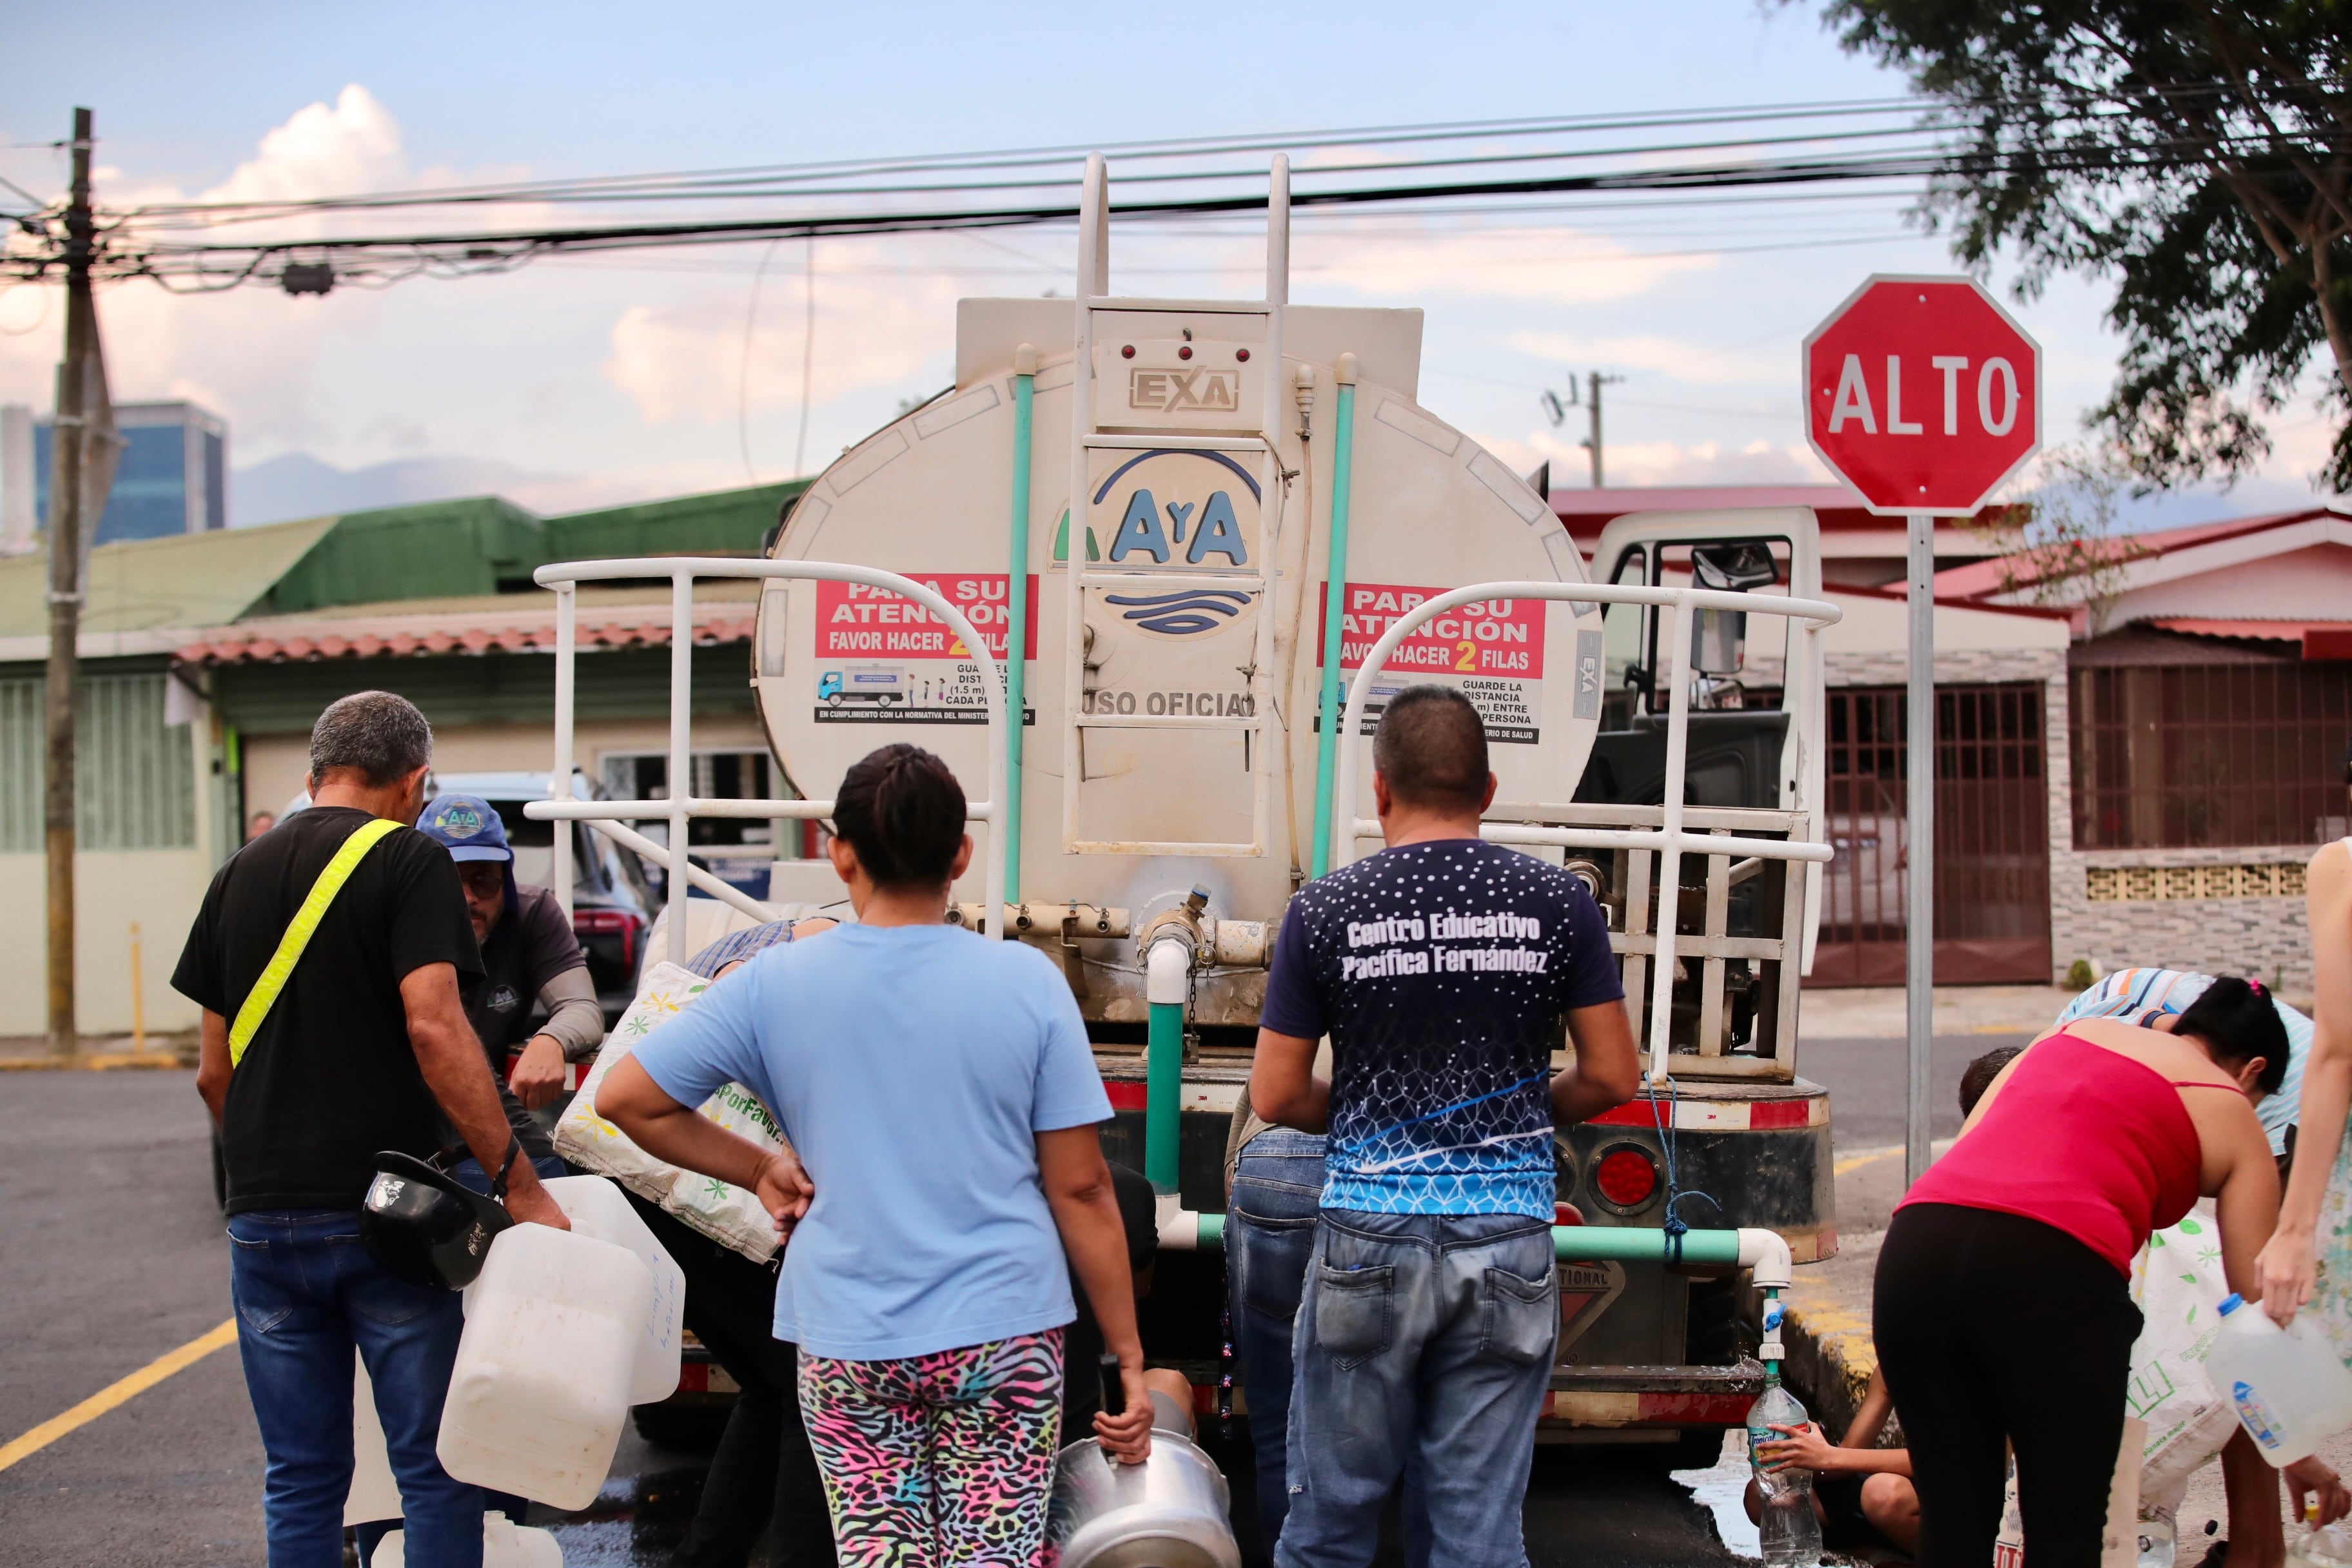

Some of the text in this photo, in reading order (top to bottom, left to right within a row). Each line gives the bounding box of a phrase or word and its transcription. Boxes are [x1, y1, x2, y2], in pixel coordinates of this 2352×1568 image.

[1137, 366, 1231, 413] EXA
[1828, 353, 2017, 437] ALTO
[956, 580, 1005, 600] SU
[1353, 590, 1513, 618] PAR SU
[829, 632, 882, 650] FAVOR
[887, 632, 944, 651] HACER
[1392, 645, 1450, 666] HACER
[1455, 641, 1476, 671] 2
[1482, 649, 1529, 670] FILAS
[1580, 657, 1598, 694] EXA
[950, 685, 985, 695] (1.5 m)
[1463, 680, 1522, 692] GUARDE LA
[946, 696, 974, 705] CADA
[1464, 691, 1520, 702] DISTANCIA
[1493, 703, 1527, 713] ENTRE
[1482, 714, 1531, 724] PERSONA
[1502, 730, 1511, 738] DE
[1512, 731, 1533, 740] SALUD
[1346, 912, 1541, 948] Centro Educativo
[1433, 943, 1548, 974] Fernández
[1749, 1431, 1776, 1447] Tropical
